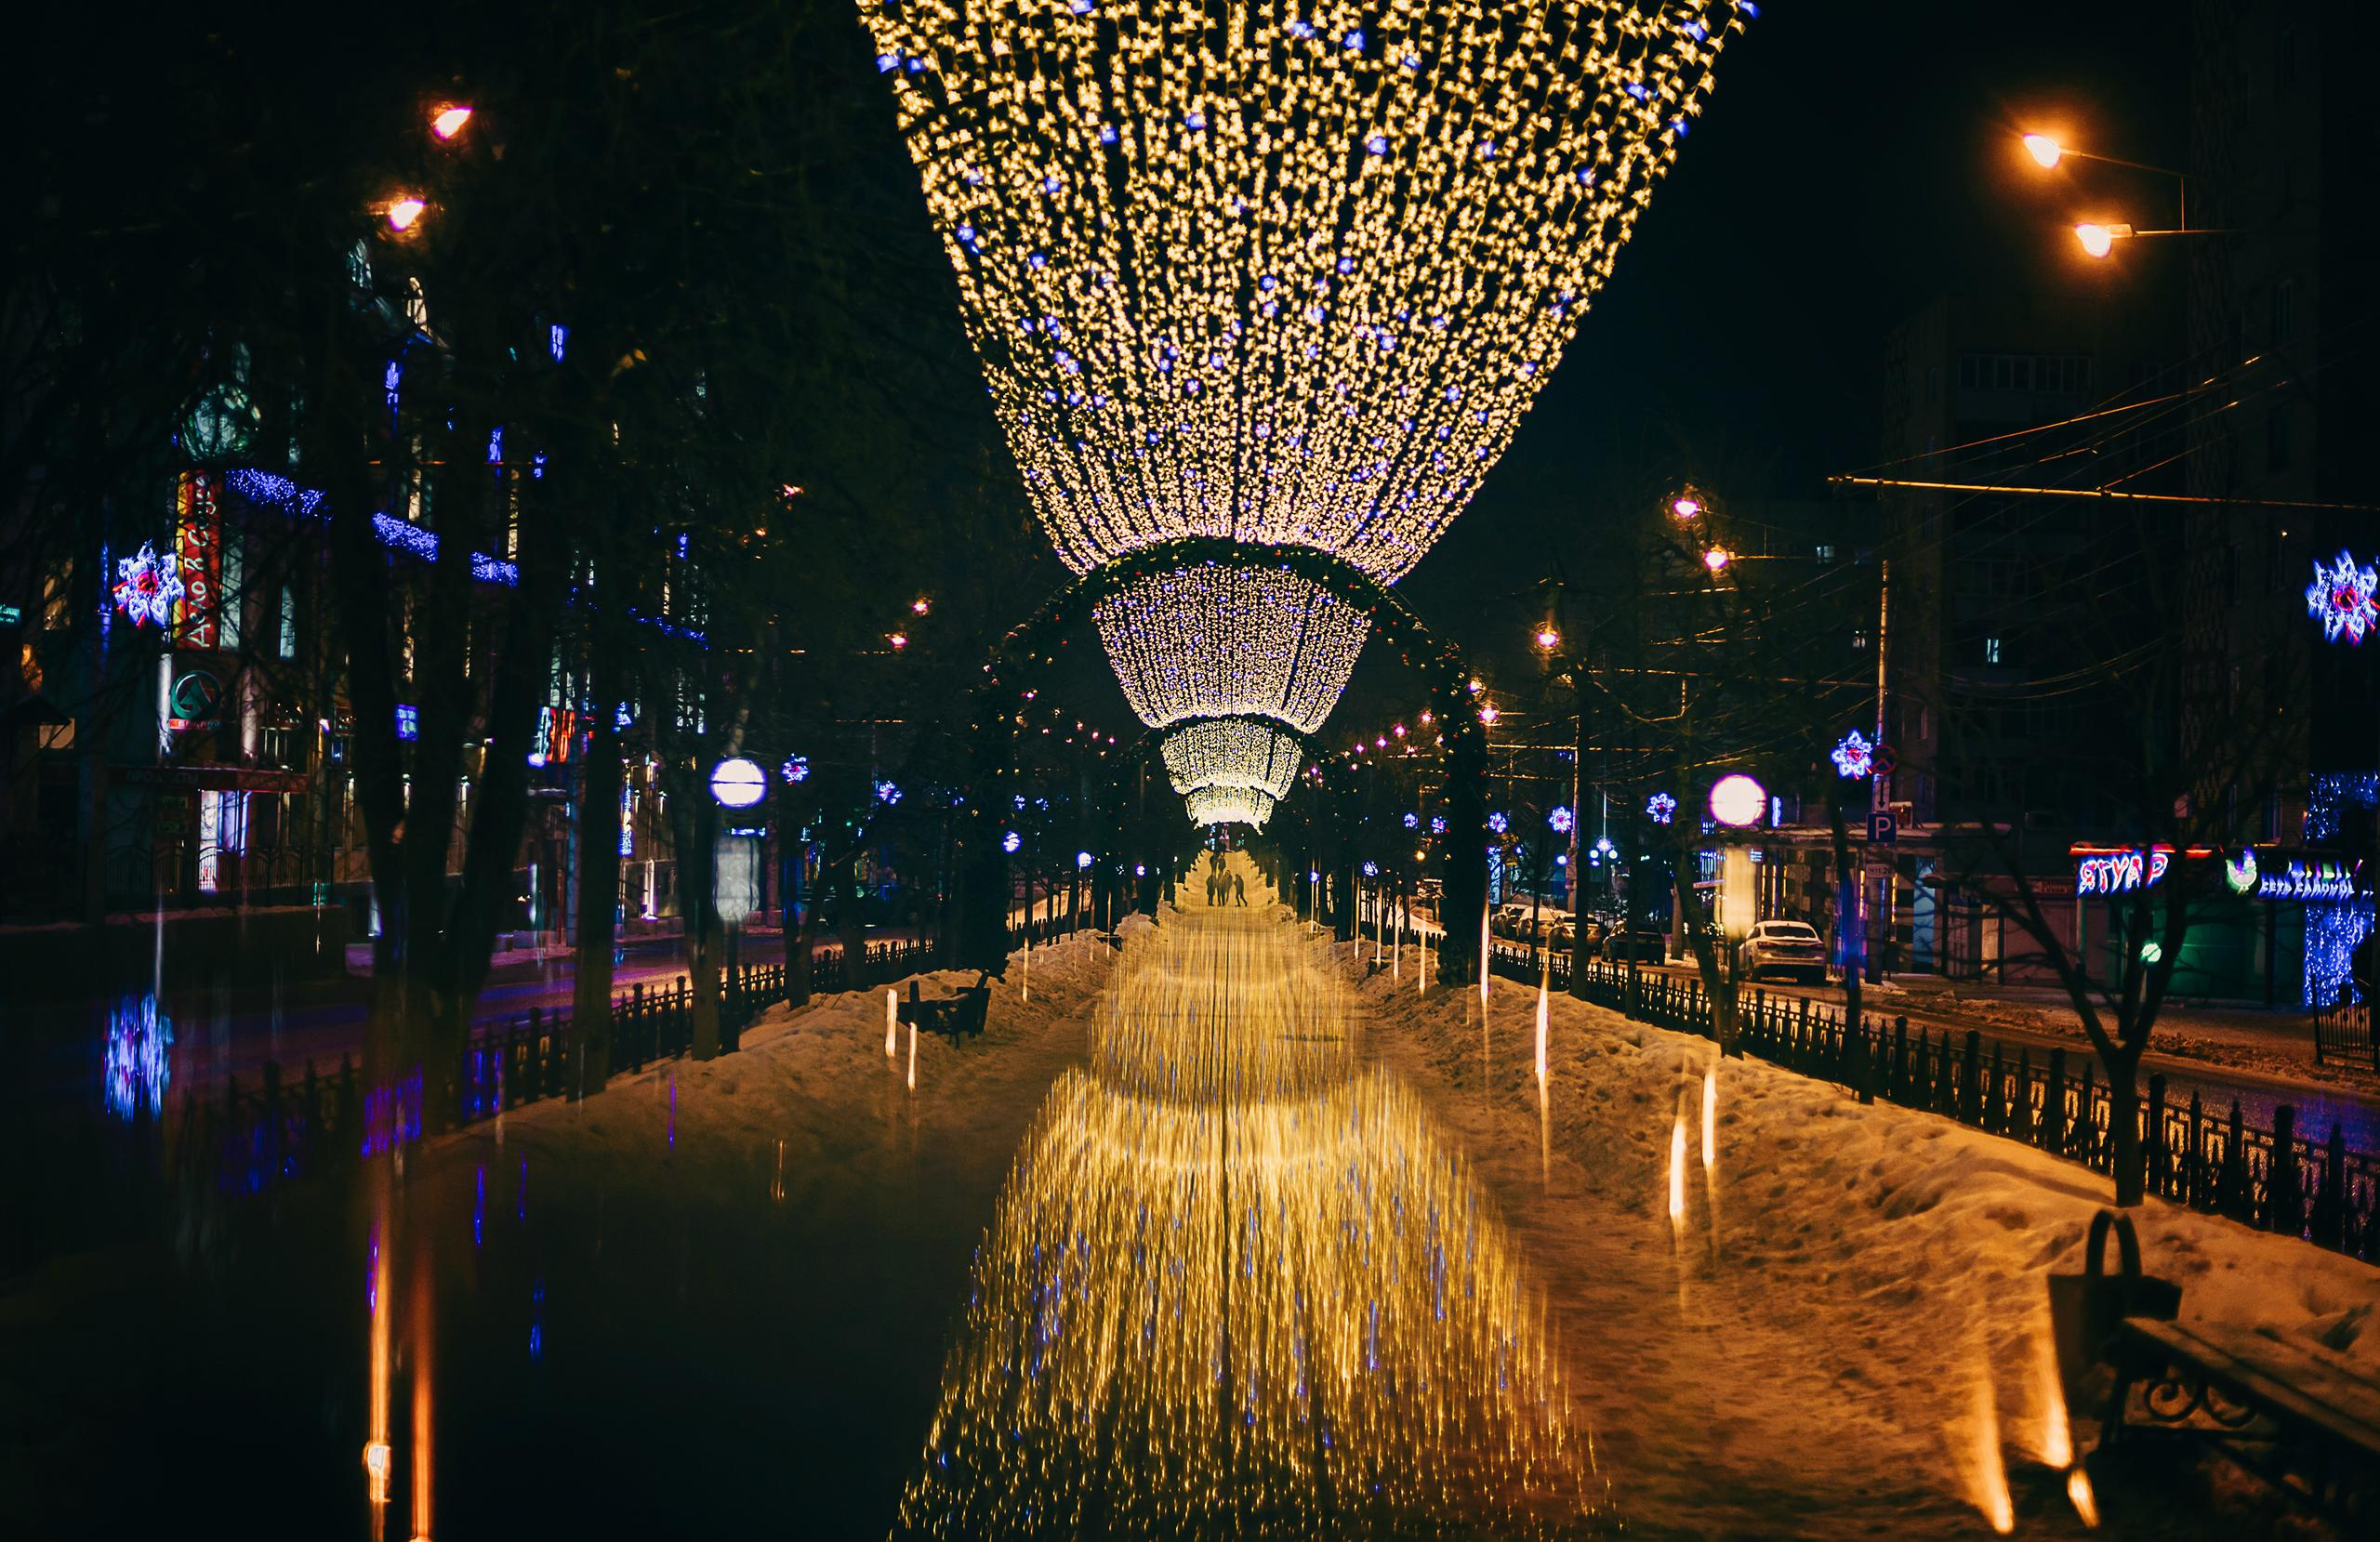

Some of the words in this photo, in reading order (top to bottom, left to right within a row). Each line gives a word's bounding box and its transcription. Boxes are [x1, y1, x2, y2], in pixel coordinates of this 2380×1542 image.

[187, 580, 211, 648] Дело
[126, 772, 199, 784] ПРОДТЫ
[1875, 816, 1891, 840] P
[2078, 852, 2168, 894] ЯГУАР
